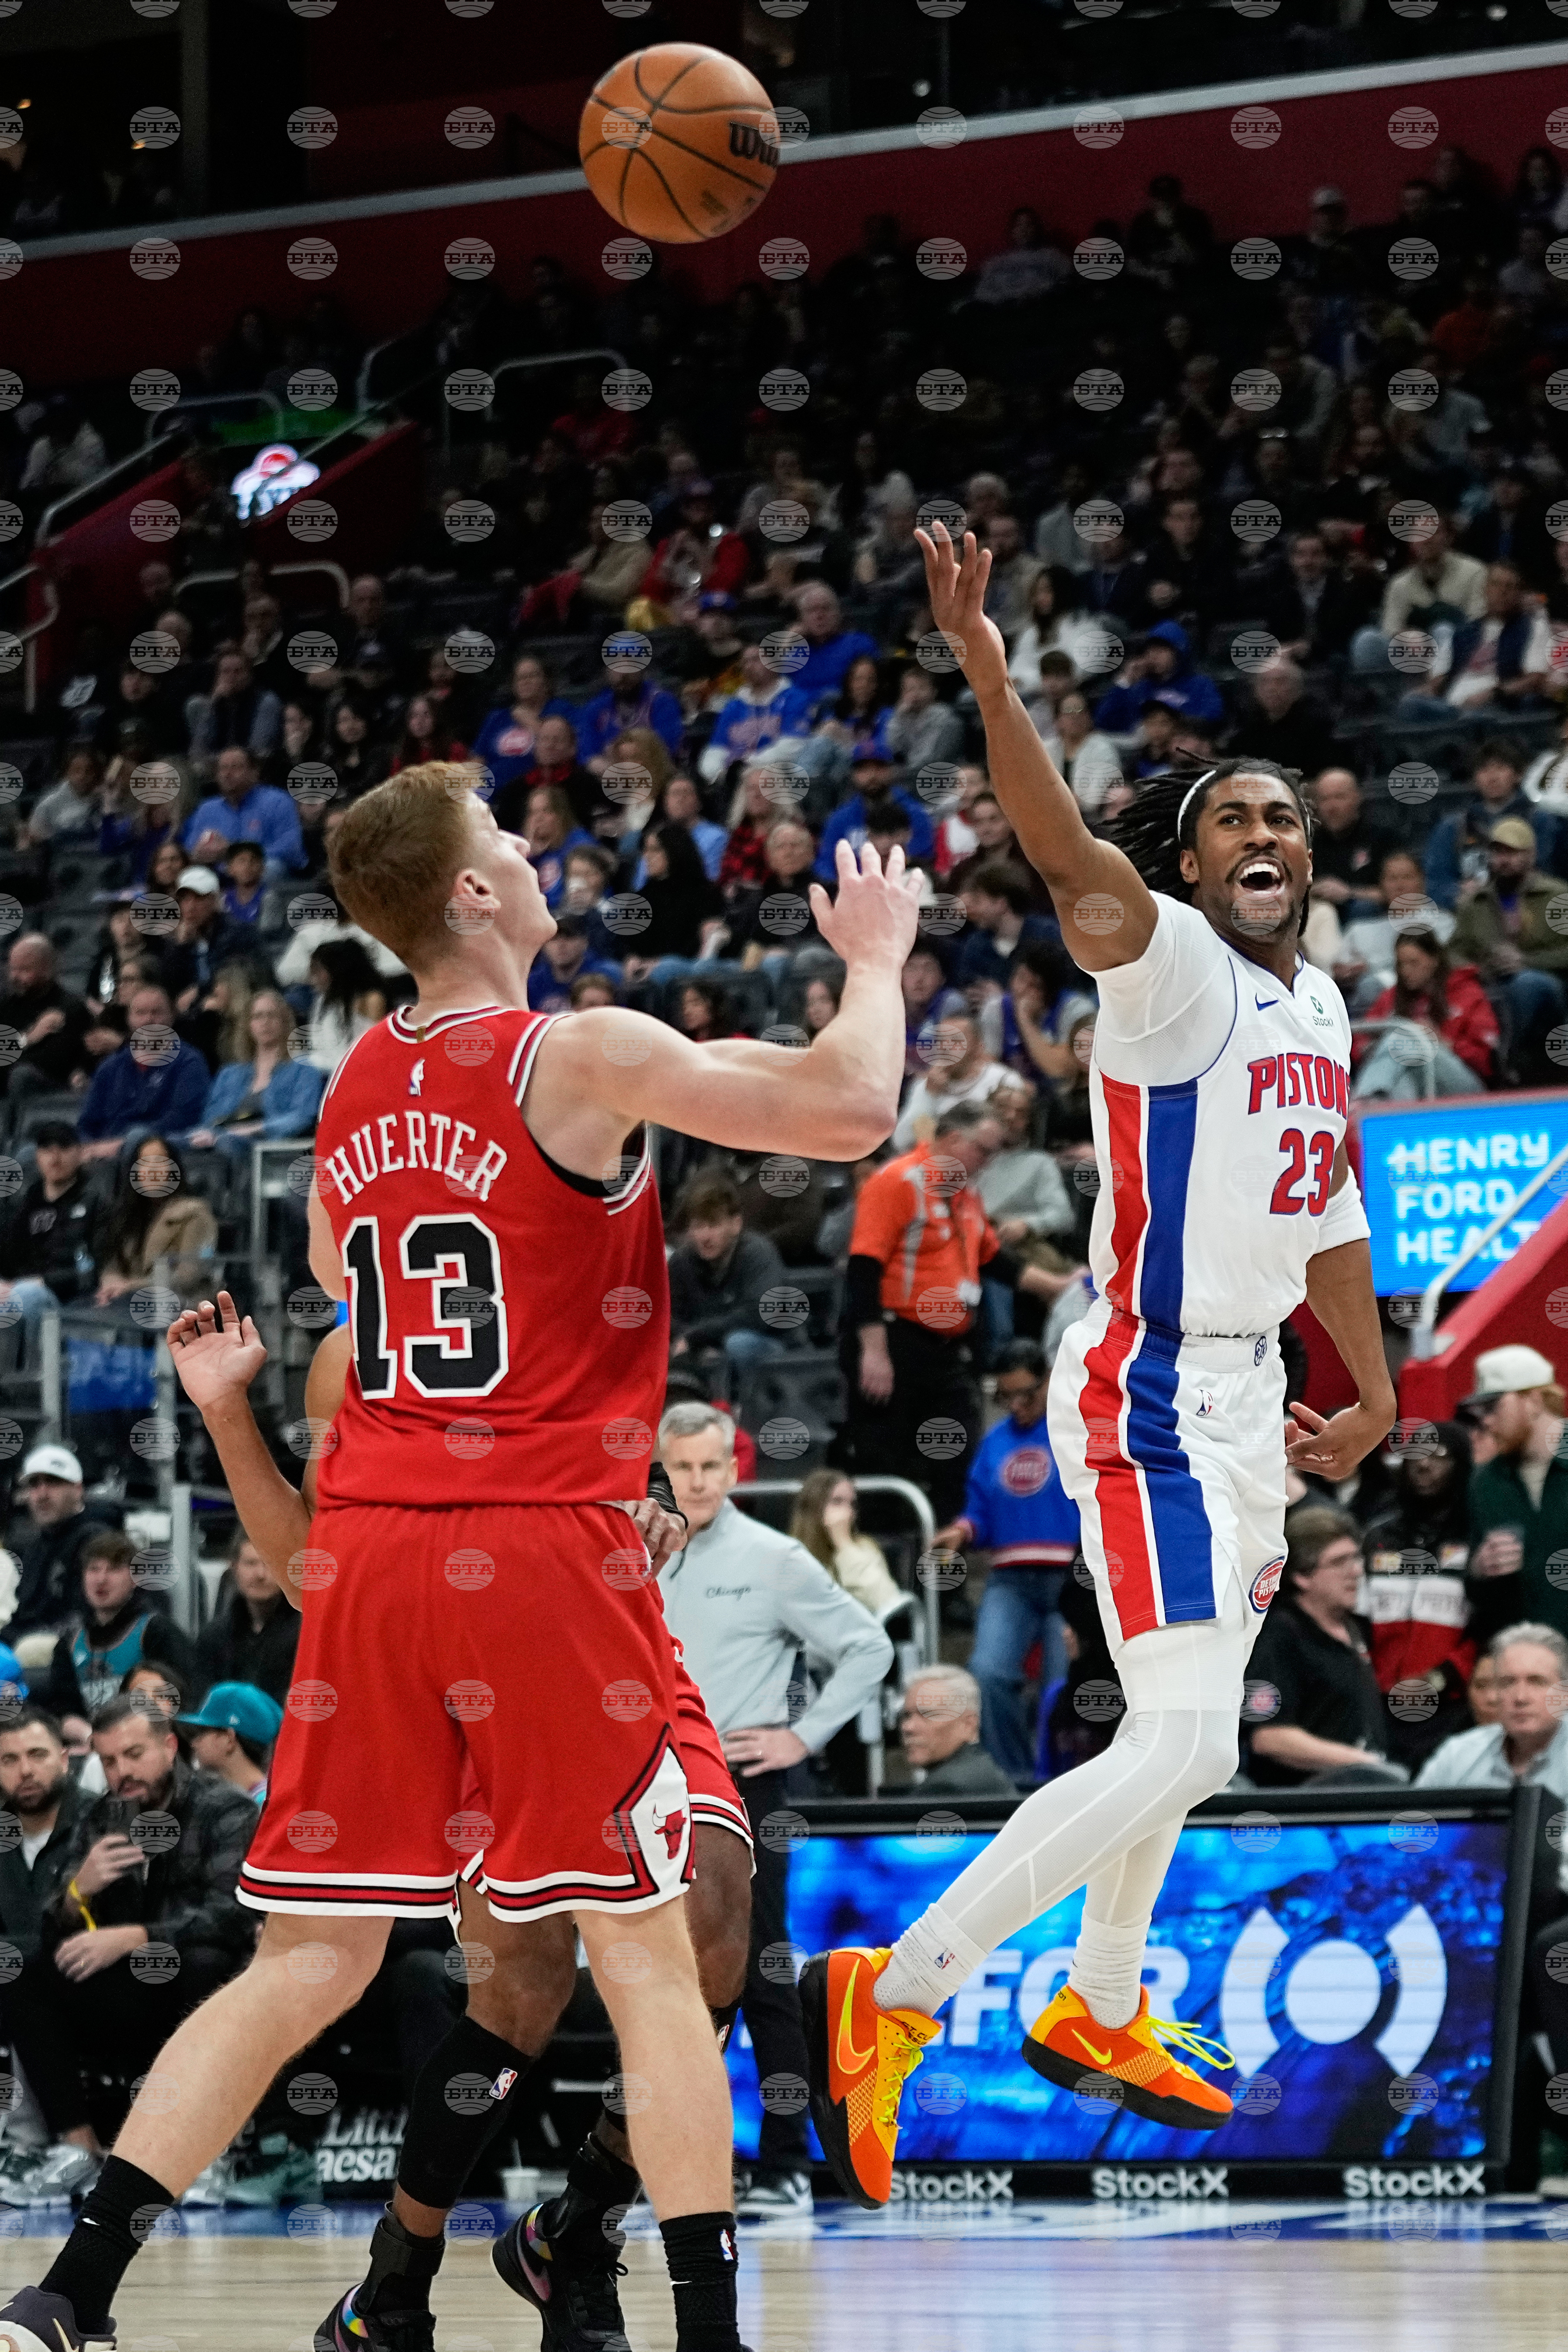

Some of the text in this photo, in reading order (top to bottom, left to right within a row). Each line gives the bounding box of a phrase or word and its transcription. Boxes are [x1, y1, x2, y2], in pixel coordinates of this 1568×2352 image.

[325, 1110, 508, 1205] HUERTER
[1270, 1128, 1335, 1217] 23
[1387, 1132, 1550, 1175] HENRY
[1396, 1179, 1517, 1219] FORD
[341, 1212, 509, 1400] 13
[890, 2169, 1013, 2200] StockX
[1093, 2165, 1229, 2199] StockX
[1344, 2162, 1485, 2199] StockX
